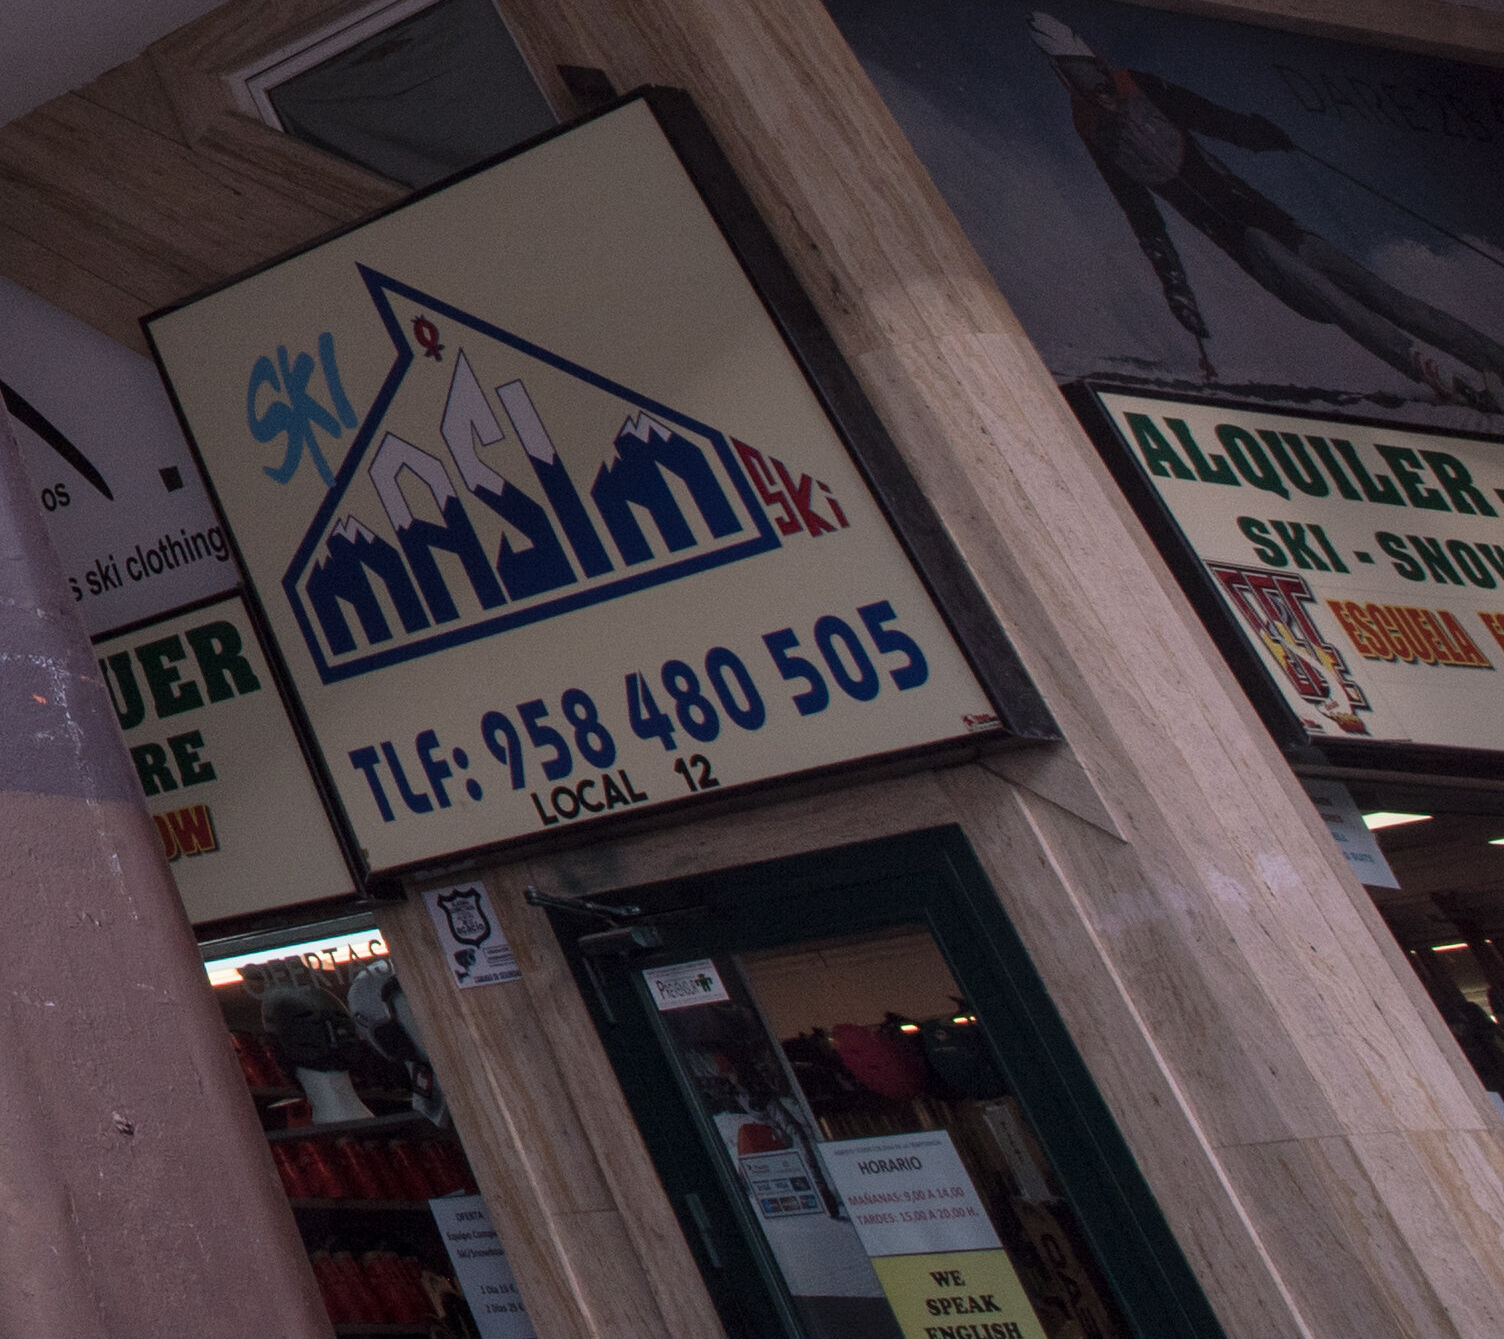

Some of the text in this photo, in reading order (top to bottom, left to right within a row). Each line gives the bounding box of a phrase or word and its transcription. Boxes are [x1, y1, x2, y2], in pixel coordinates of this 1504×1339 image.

[246, 331, 359, 488] SKI
[1122, 410, 1500, 518] ALQUILER
[85, 554, 124, 596] ski
[125, 526, 230, 582] clothing
[1237, 516, 1351, 574] SKI
[1325, 598, 1495, 671] ESCUELA
[98, 620, 262, 731] UER
[348, 599, 930, 823] TLF: 958 480 505
[531, 753, 721, 826] LOCAL 12
[857, 1156, 923, 1175] HORARIO
[925, 1294, 1002, 1317] SPEAK
[929, 1269, 966, 1287] WE
